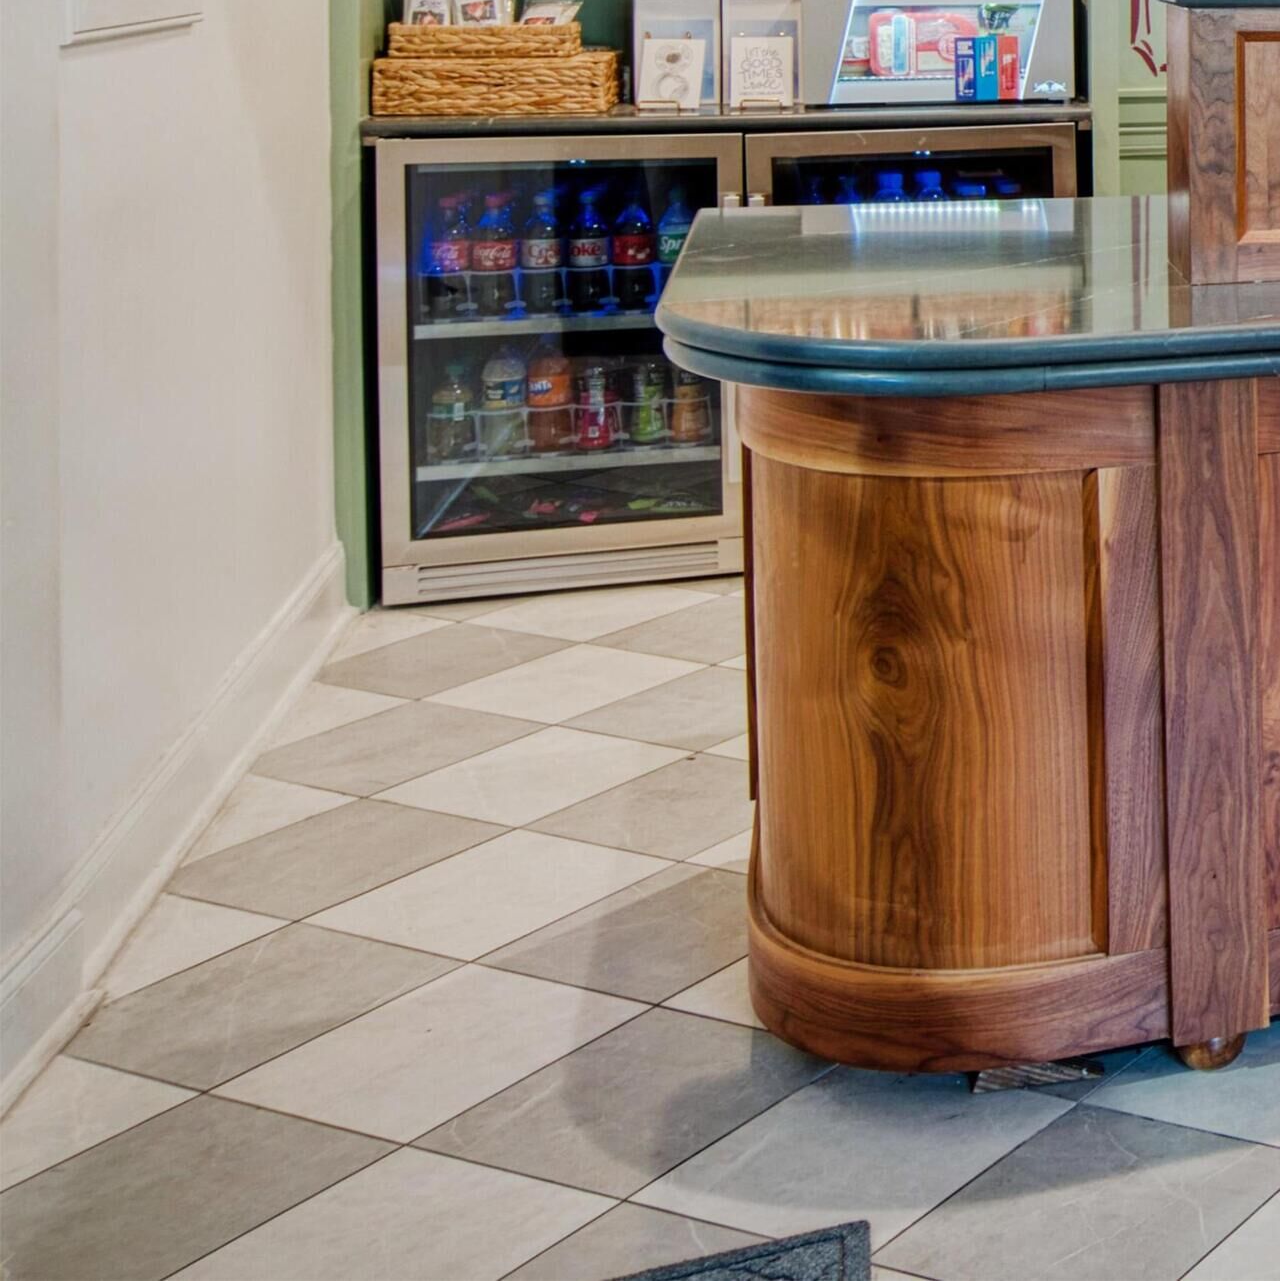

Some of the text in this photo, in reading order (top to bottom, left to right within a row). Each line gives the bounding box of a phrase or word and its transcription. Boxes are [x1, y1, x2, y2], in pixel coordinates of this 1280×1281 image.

[740, 58, 783, 69] GOOD
[738, 68, 783, 83] TIMES
[567, 242, 601, 256] oke
[659, 236, 684, 252] Spr
